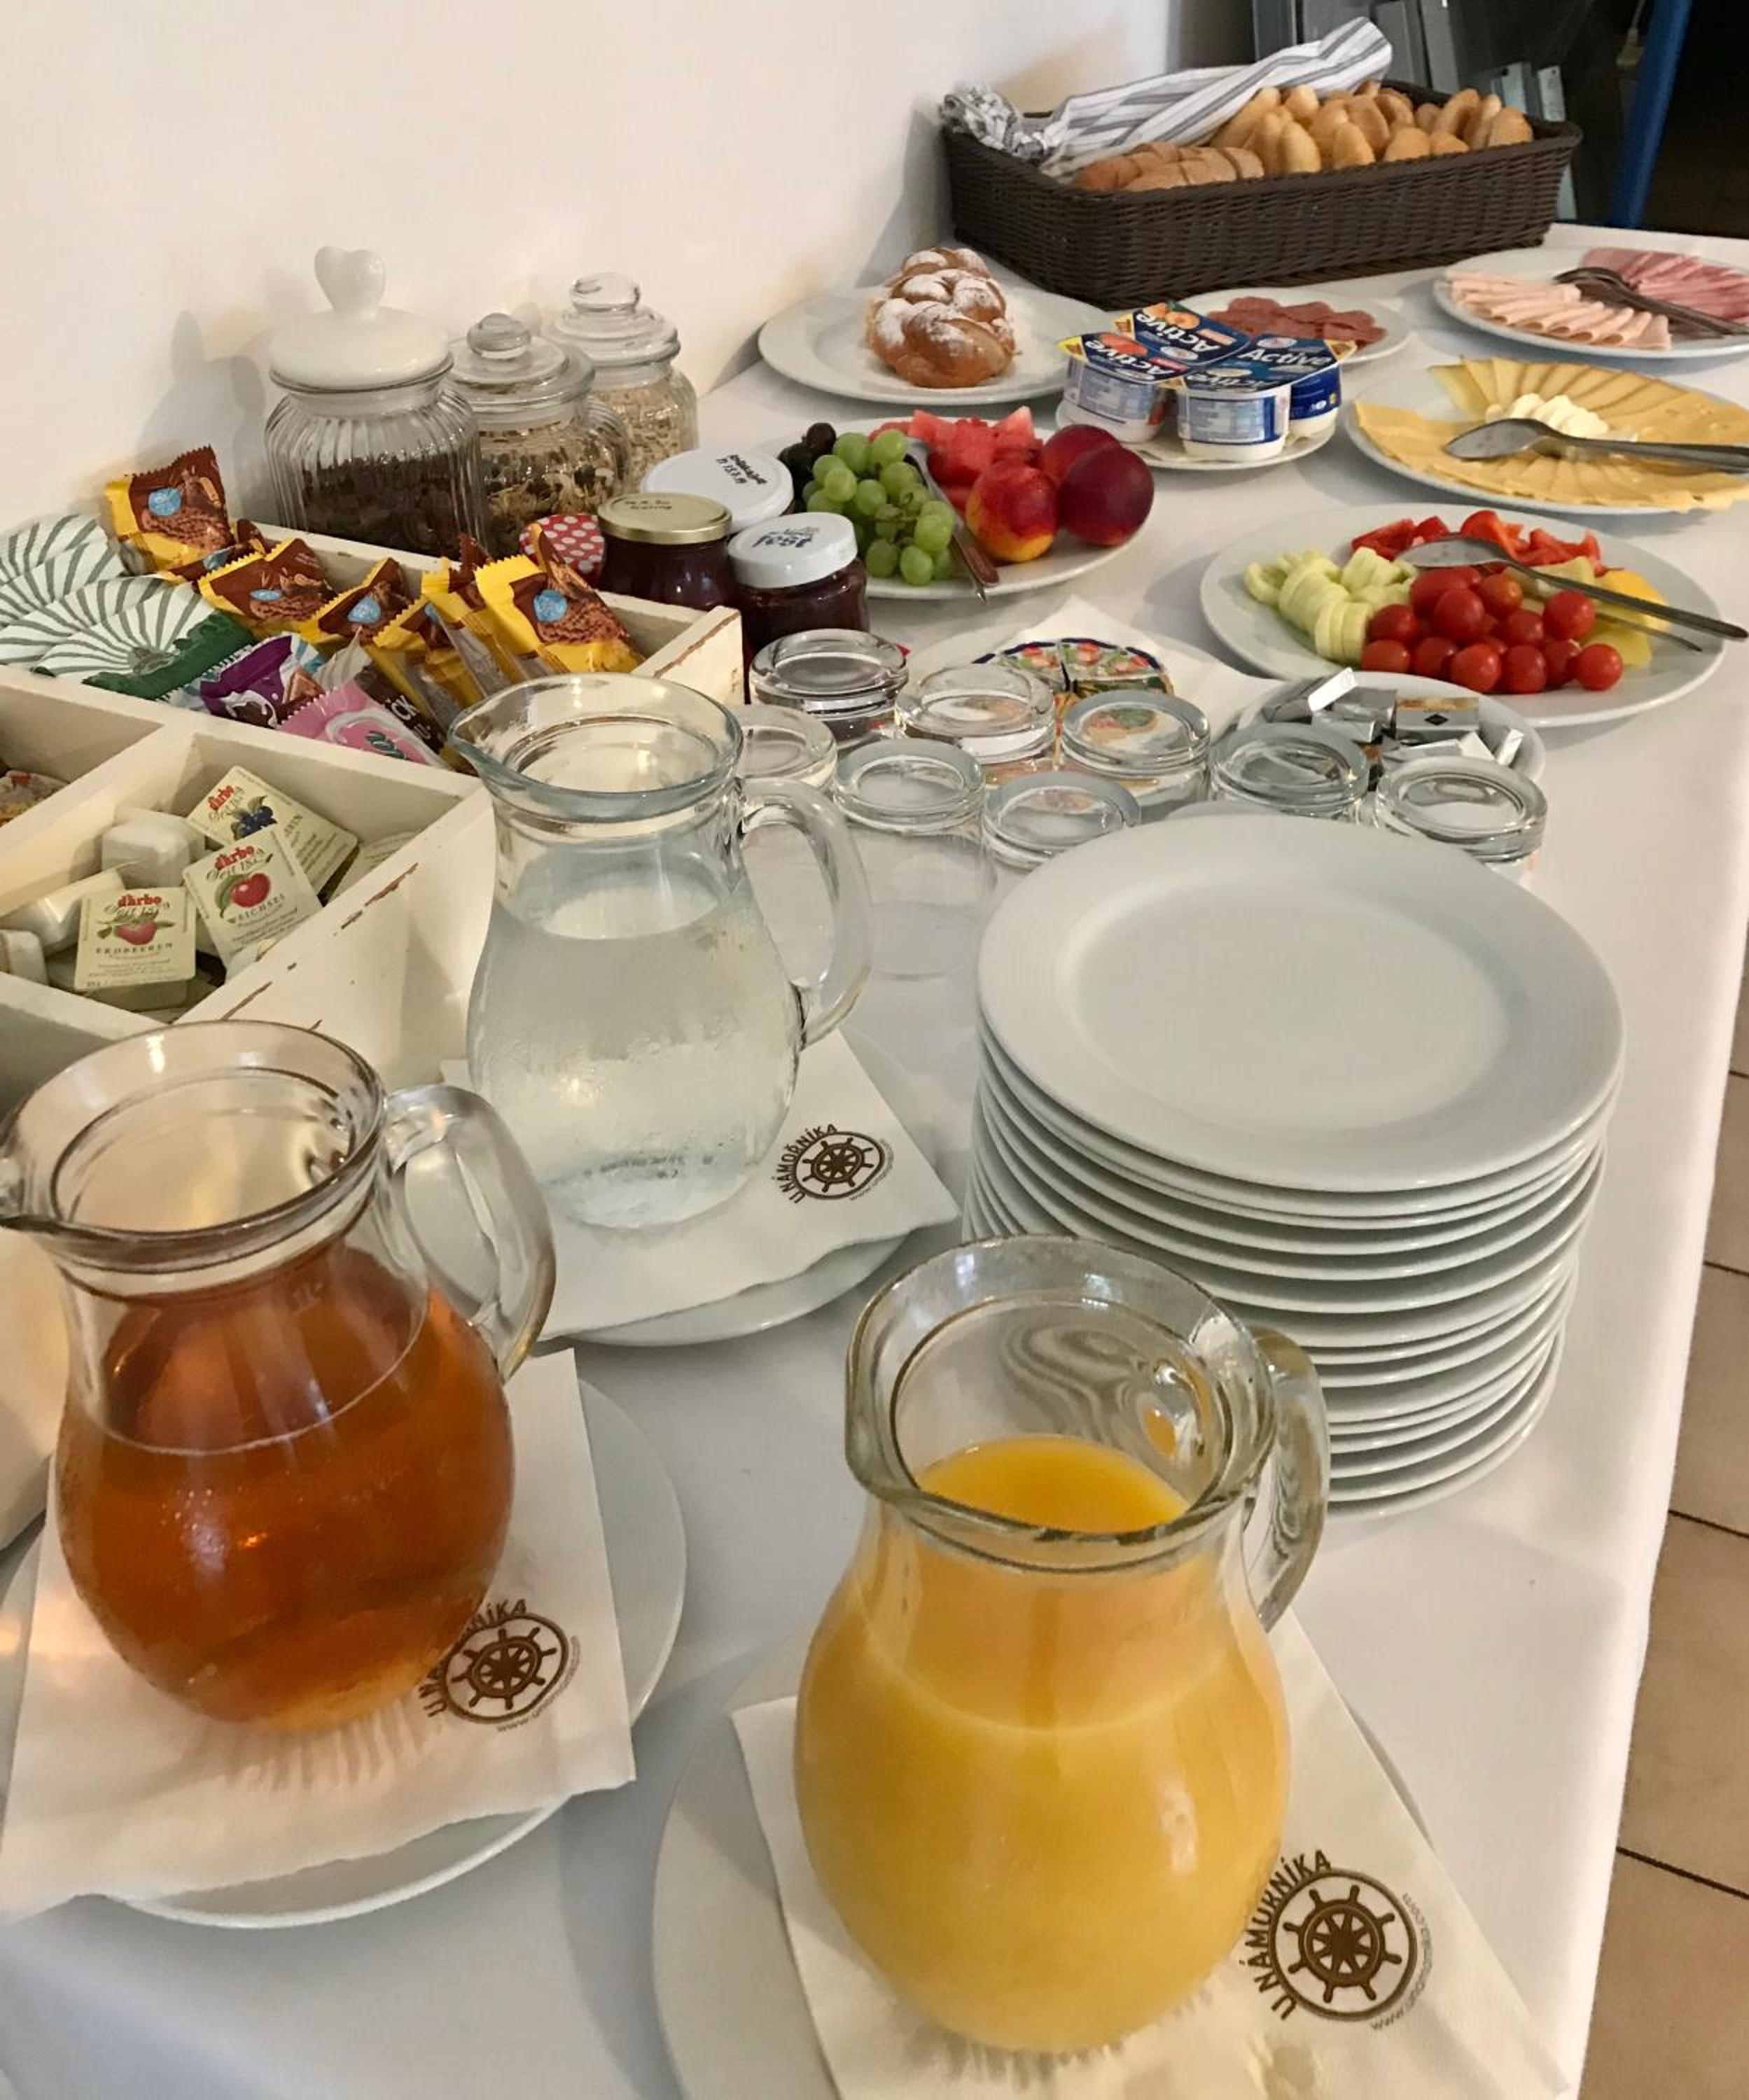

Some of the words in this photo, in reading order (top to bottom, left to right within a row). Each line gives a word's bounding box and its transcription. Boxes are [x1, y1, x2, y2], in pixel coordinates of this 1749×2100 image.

[1136, 313, 1221, 352] Active
[1085, 339, 1176, 374] Active
[1236, 349, 1333, 365] Active
[788, 1191, 807, 1204] U
[1271, 1994, 1297, 2021] U
